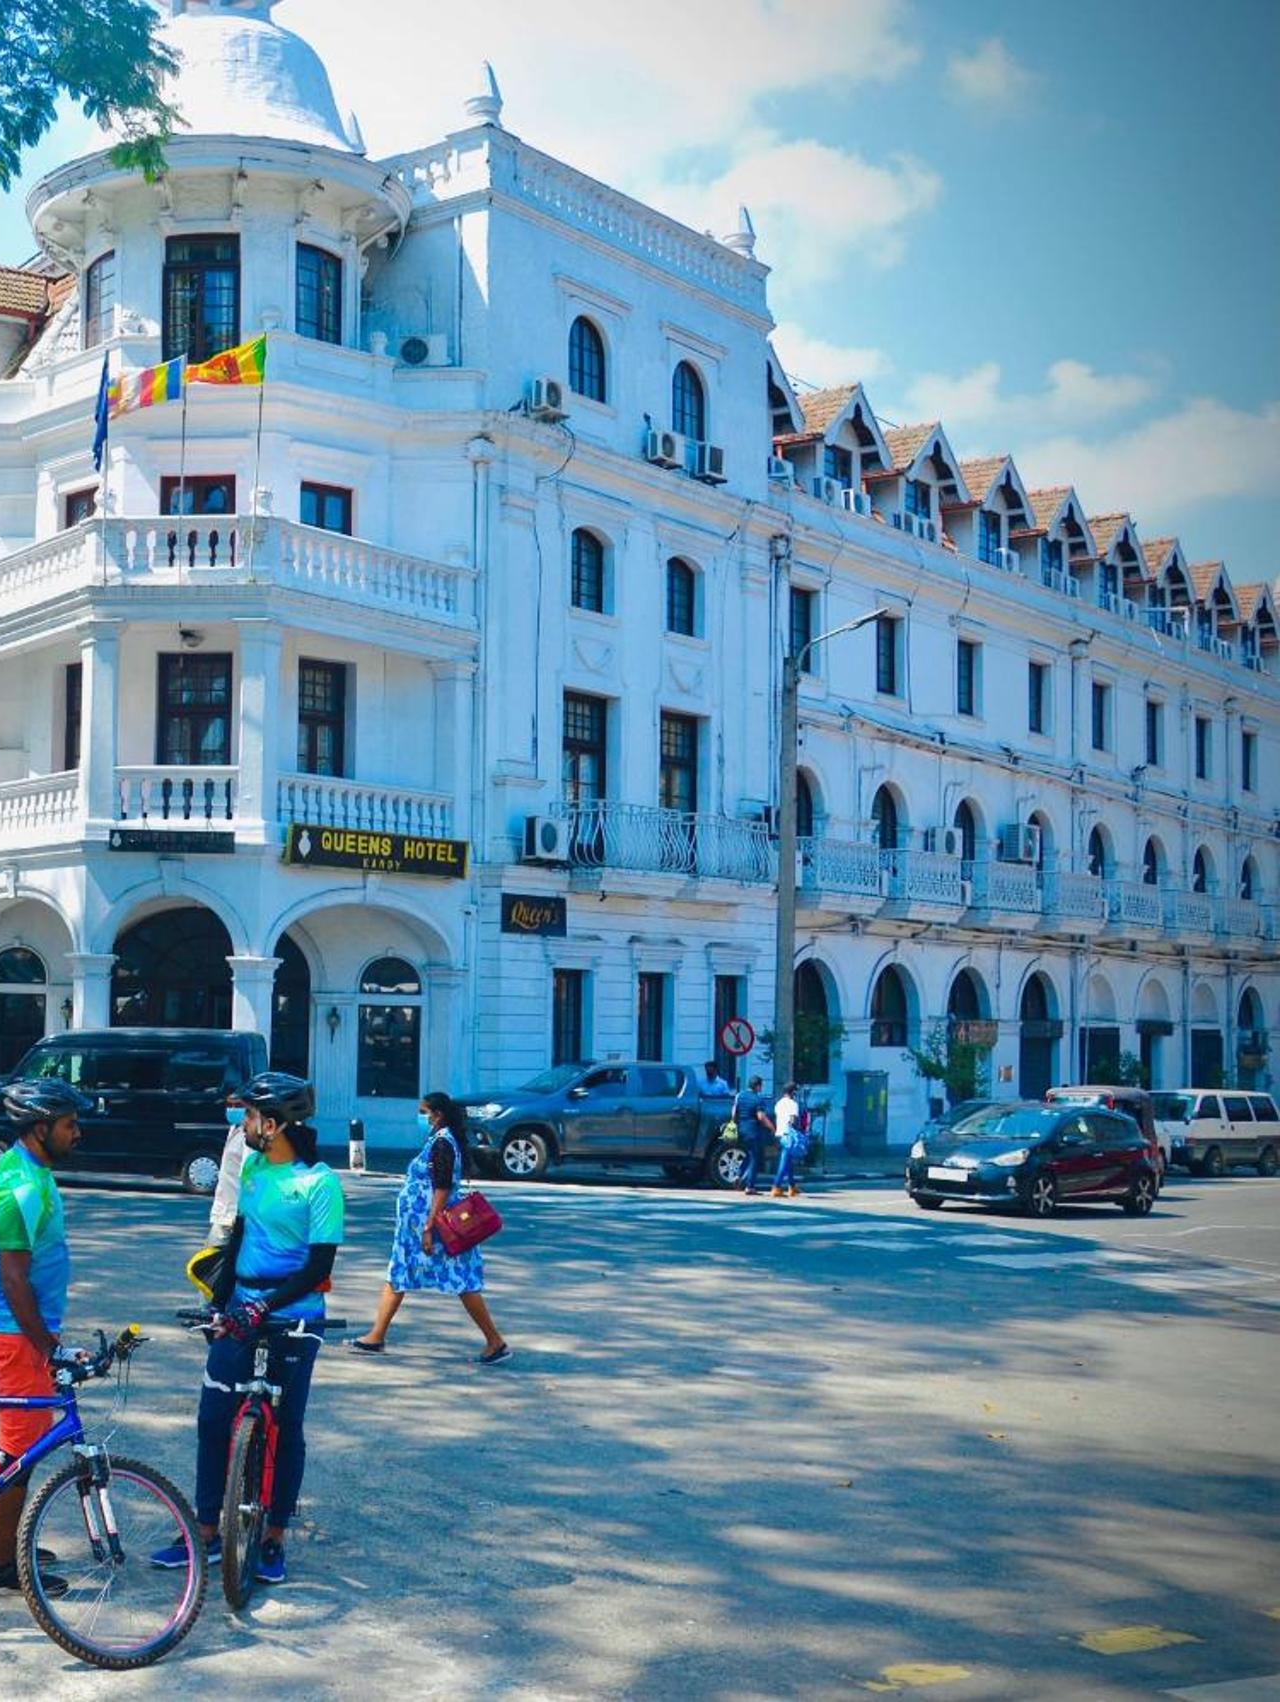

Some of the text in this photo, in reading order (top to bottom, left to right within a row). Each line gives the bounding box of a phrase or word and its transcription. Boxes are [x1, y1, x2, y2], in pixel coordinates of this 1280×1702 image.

[321, 831, 458, 863] QUEENS HOTEL
[362, 858, 401, 871] KANDY
